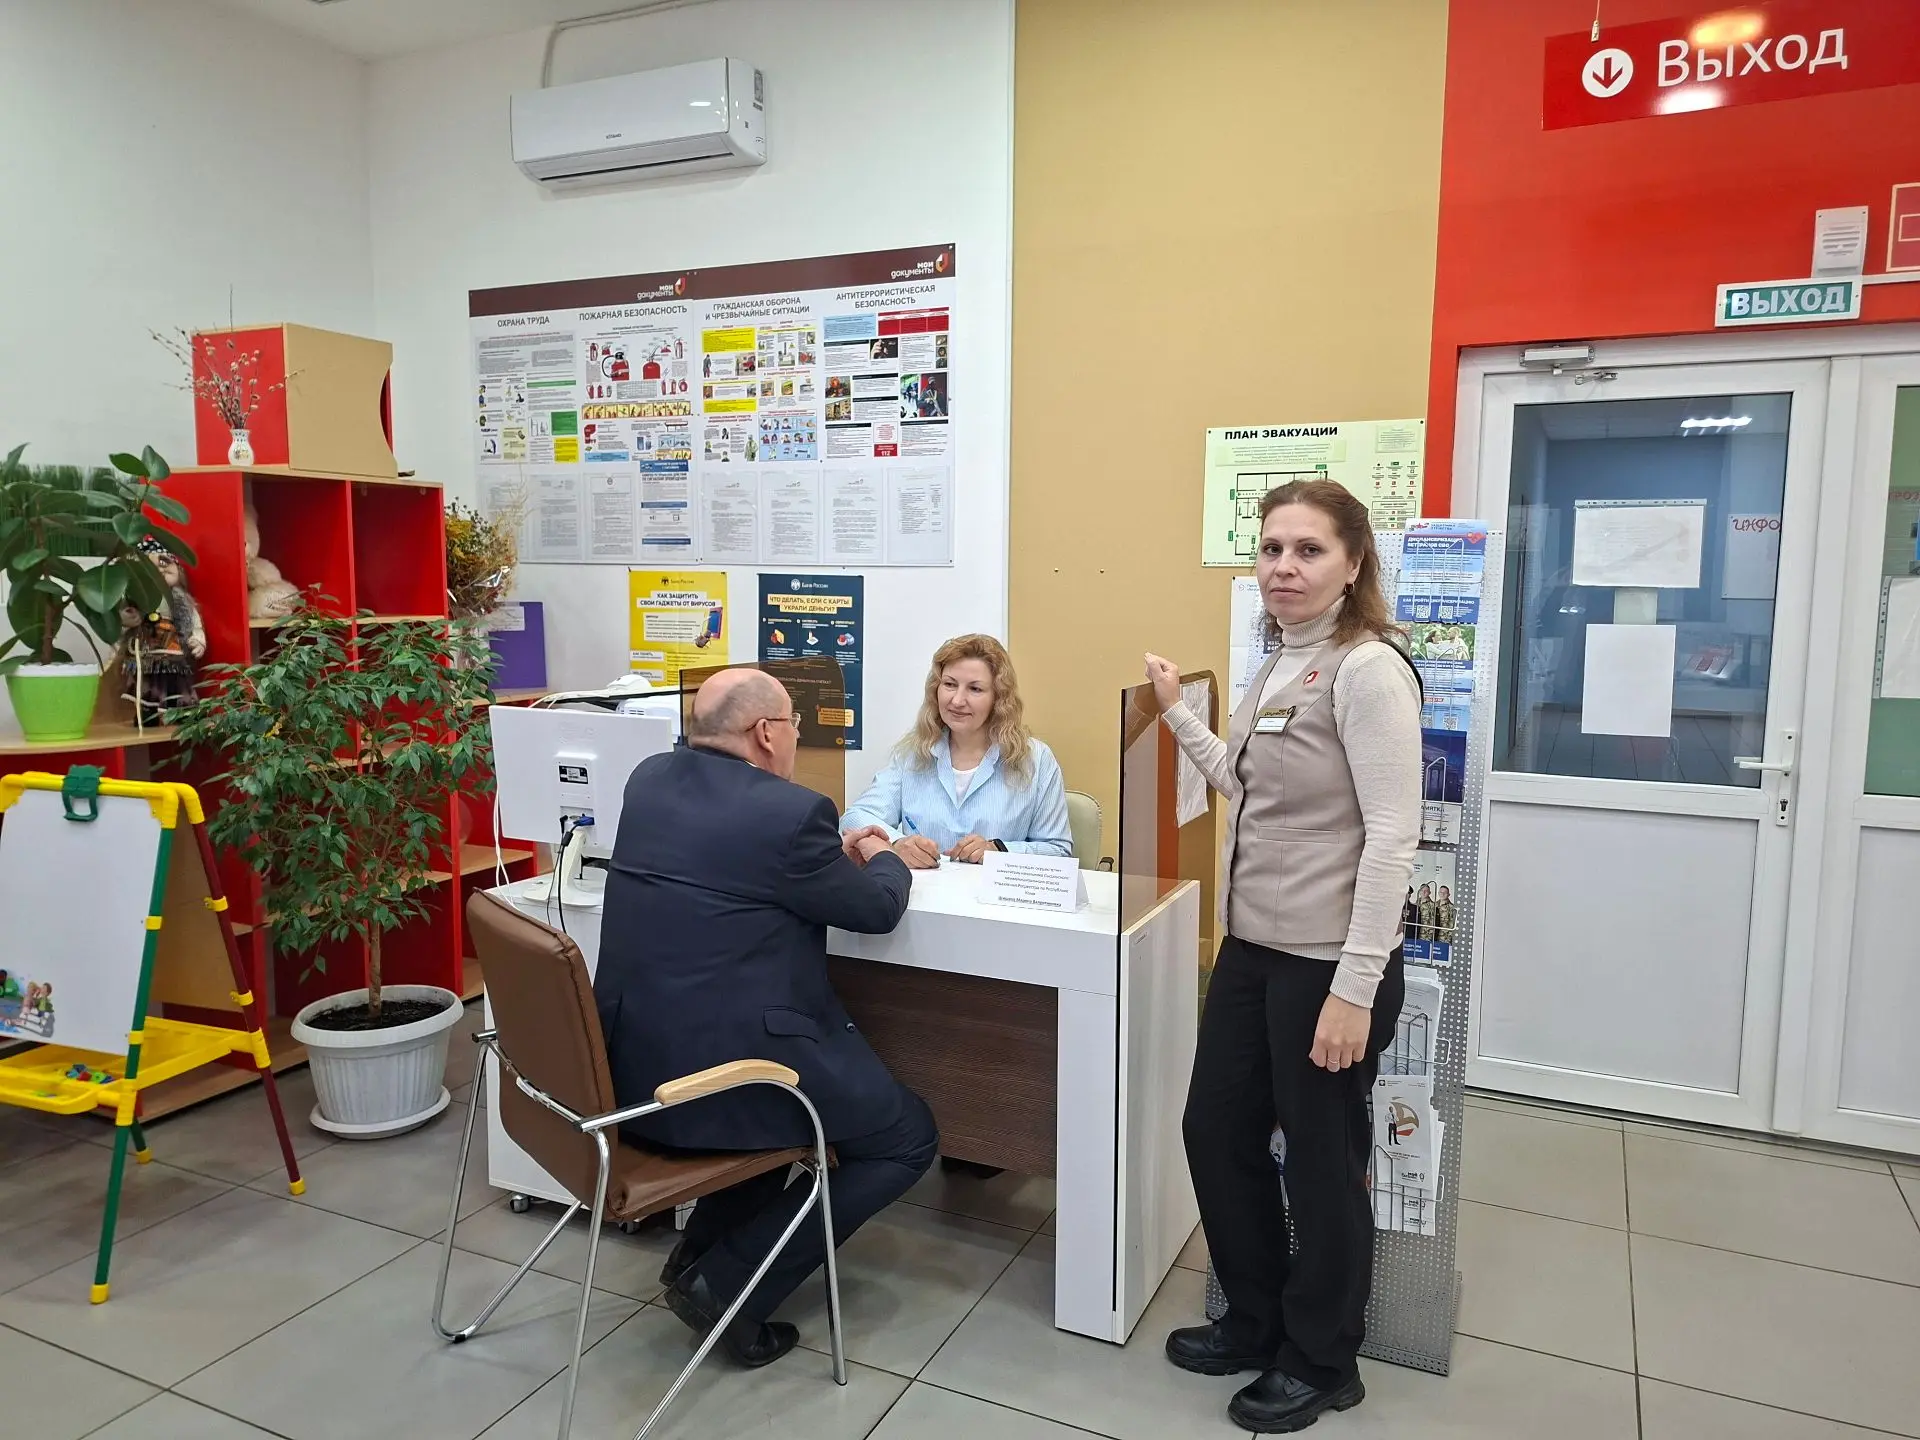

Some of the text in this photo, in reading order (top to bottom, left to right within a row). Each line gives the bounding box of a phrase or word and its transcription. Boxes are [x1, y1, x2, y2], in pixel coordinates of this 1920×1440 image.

[1657, 27, 1849, 88] Выход
[890, 267, 934, 279] документы
[836, 284, 936, 301] АНТИТЕРРОРИСТИЧЕСКАЯ
[713, 296, 801, 311] ГРАЖДАНСКАЯ ОБОРОНА
[855, 296, 916, 309] БЕЗОПАСНОСТЬ
[1730, 285, 1846, 316] ВЫХОД
[579, 305, 687, 322] ПОЖАРНАЯ БЕЗОПАСНОСТЬ
[705, 305, 810, 321] И ЧРЕЗВЫЧАЙНЫЕ СИТУАЦИИ
[497, 315, 550, 328] ОХРАНА ТРУДА
[1225, 426, 1338, 440] ПЛАН ЭВАКУАЦИИ
